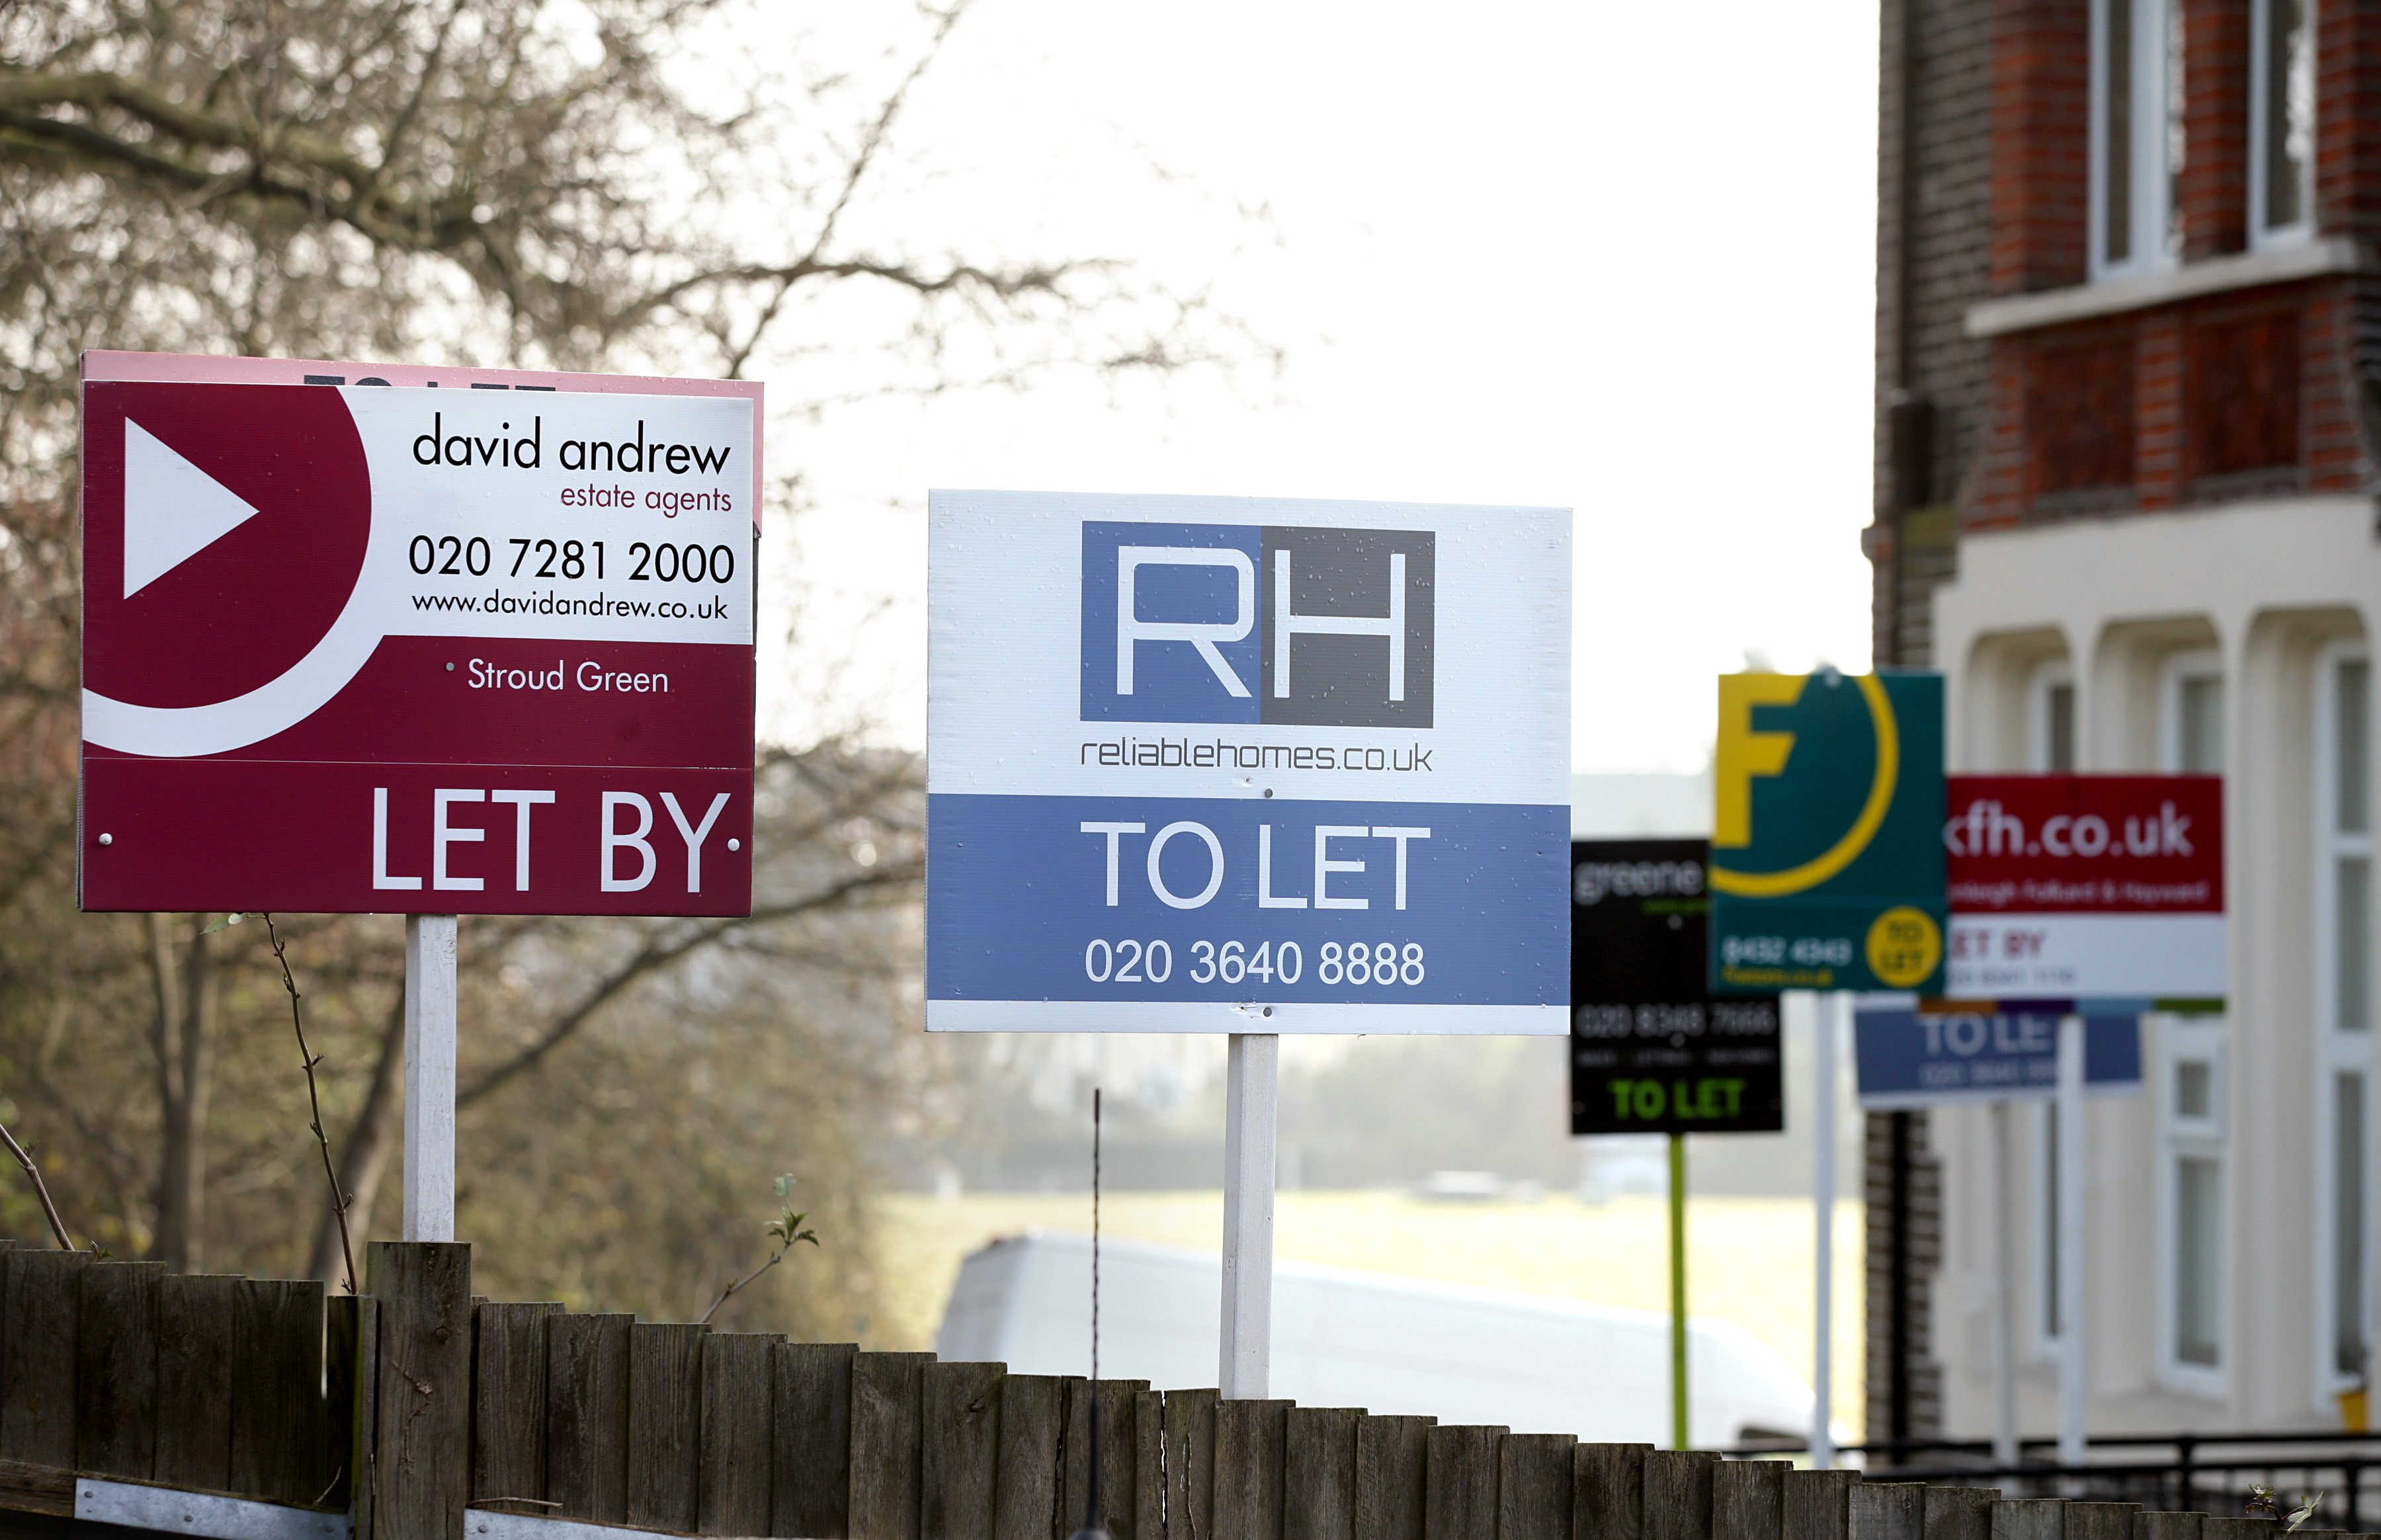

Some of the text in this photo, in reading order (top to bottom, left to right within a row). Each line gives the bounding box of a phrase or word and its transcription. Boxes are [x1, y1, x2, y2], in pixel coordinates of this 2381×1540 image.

[413, 411, 731, 475] david andrew
[560, 484, 732, 518] estate agents
[408, 535, 735, 585] 020 7281 2000
[411, 588, 729, 620] www.davidandrew.co.uk
[1116, 545, 1407, 702] RH
[467, 658, 669, 694] Stroud Green
[1080, 736, 1434, 772] reliablehomes.co.uk
[372, 787, 731, 893] LET BY
[1079, 821, 1432, 911] TO LET
[1575, 862, 1702, 904] greene
[1949, 882, 2017, 907] nleigh
[1887, 921, 1923, 942] TO
[1950, 930, 2047, 959] ET BY
[1085, 938, 1425, 987] 020 3640 8888
[1790, 938, 1853, 966] 4343
[1880, 950, 1924, 973] LET
[1576, 1004, 1632, 1037] 020
[1635, 1003, 1705, 1036] 8348
[1919, 1013, 2050, 1056] TO LE
[1607, 1078, 1747, 1119] TO LET
